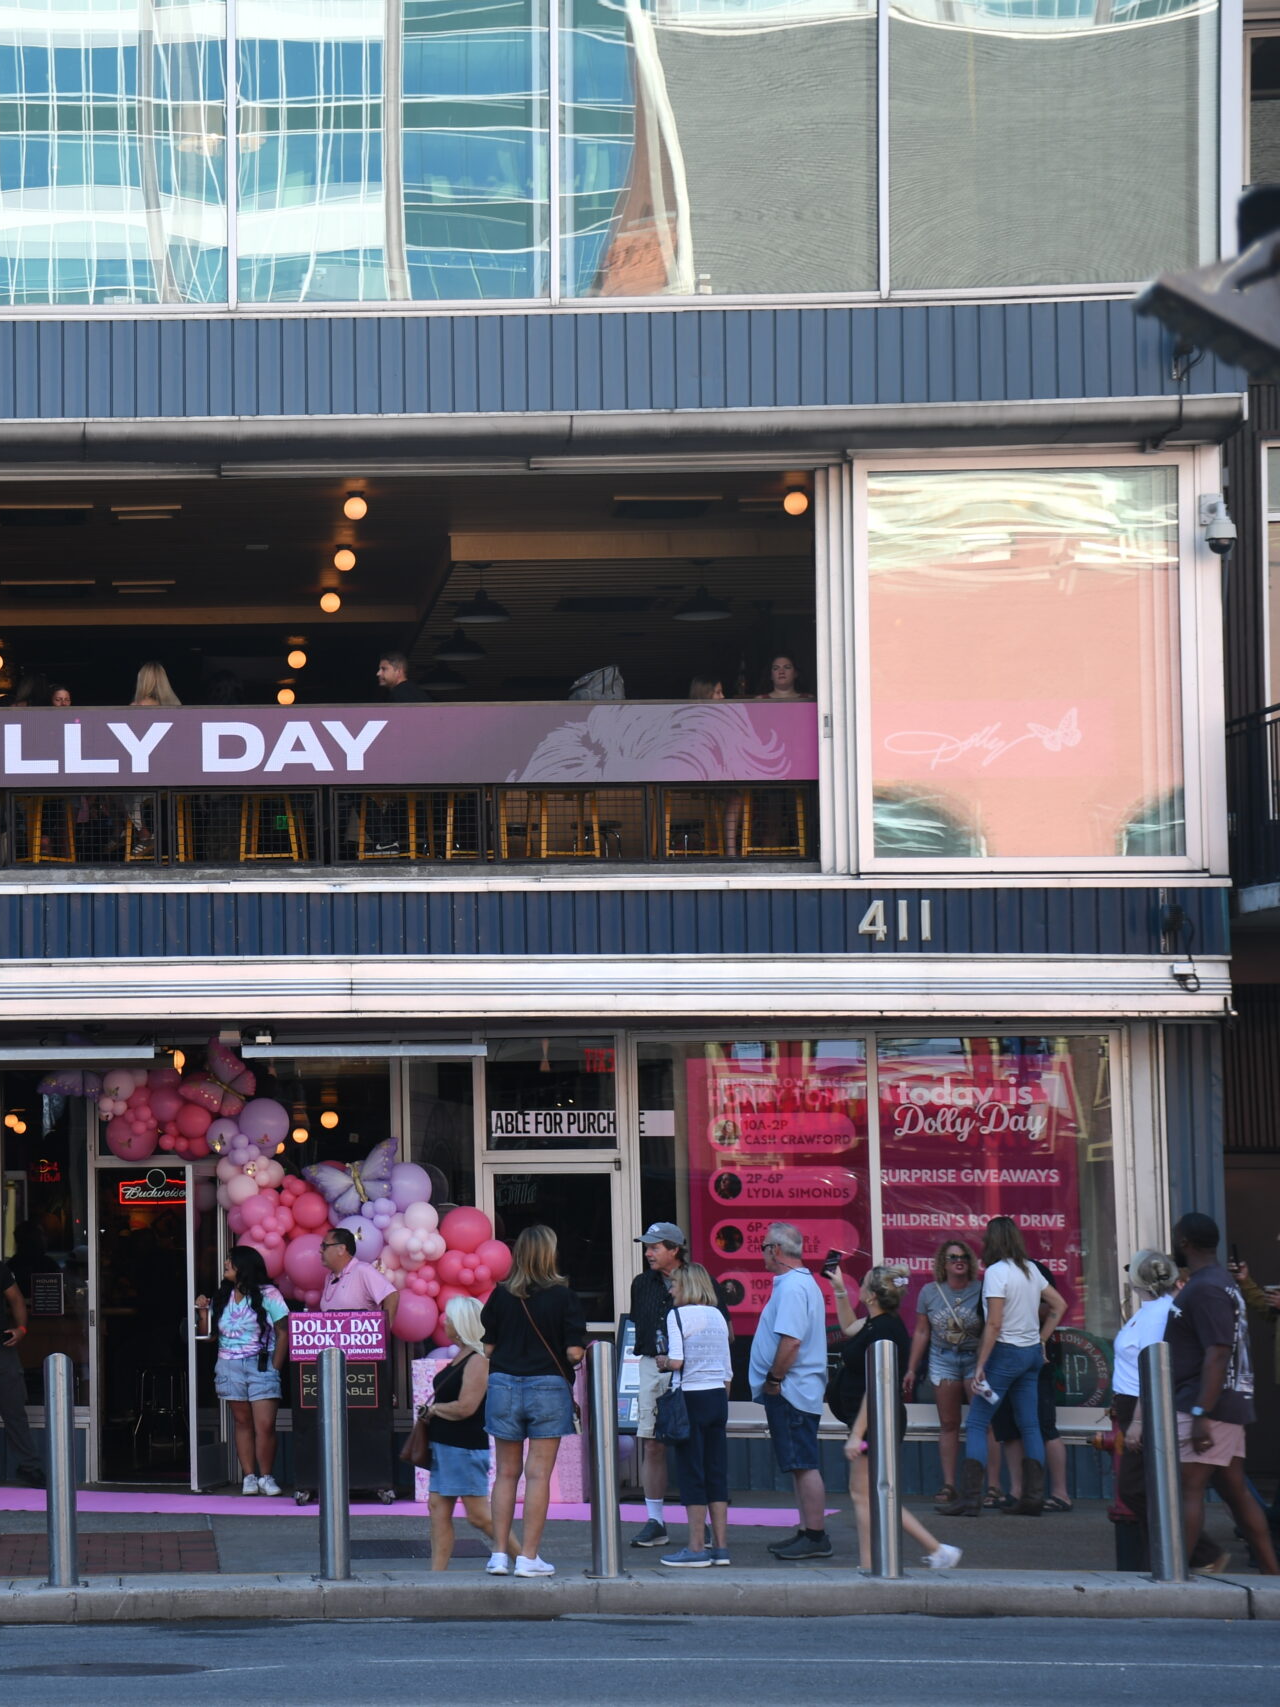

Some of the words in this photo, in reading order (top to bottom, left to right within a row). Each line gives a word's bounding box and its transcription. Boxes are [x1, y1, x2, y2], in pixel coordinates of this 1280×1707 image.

[201, 720, 389, 772] DAY
[884, 722, 1036, 770] Dolly
[858, 900, 931, 941] 411
[897, 1077, 993, 1113] today
[1009, 1077, 1033, 1105] is
[492, 1111, 530, 1134] ABLE
[535, 1111, 563, 1134] FOR
[744, 1120, 788, 1130] 10A-2P
[894, 1104, 975, 1141] Dolly
[979, 1102, 1047, 1140] Day
[744, 1134, 777, 1145] CASH
[781, 1134, 851, 1145] CRAWFORD
[746, 1173, 783, 1184] 2P-6P
[880, 1169, 956, 1183] SURPRISE
[960, 1169, 1060, 1183] GIVEAWAYS
[122, 1186, 186, 1199] Budweise
[747, 1188, 784, 1198] LYDIA
[788, 1187, 849, 1198] SIMONDS
[882, 1213, 964, 1227] CHILDREN'S
[1021, 1214, 1065, 1227] DRIVE
[884, 1257, 934, 1271] RIBUTE
[291, 1319, 345, 1333] DOLLY
[350, 1319, 382, 1332] DAY
[292, 1333, 336, 1346] BOOK
[340, 1333, 383, 1346] DROP
[302, 1374, 317, 1383] SE
[346, 1374, 375, 1383] OST
[303, 1387, 317, 1396] FO
